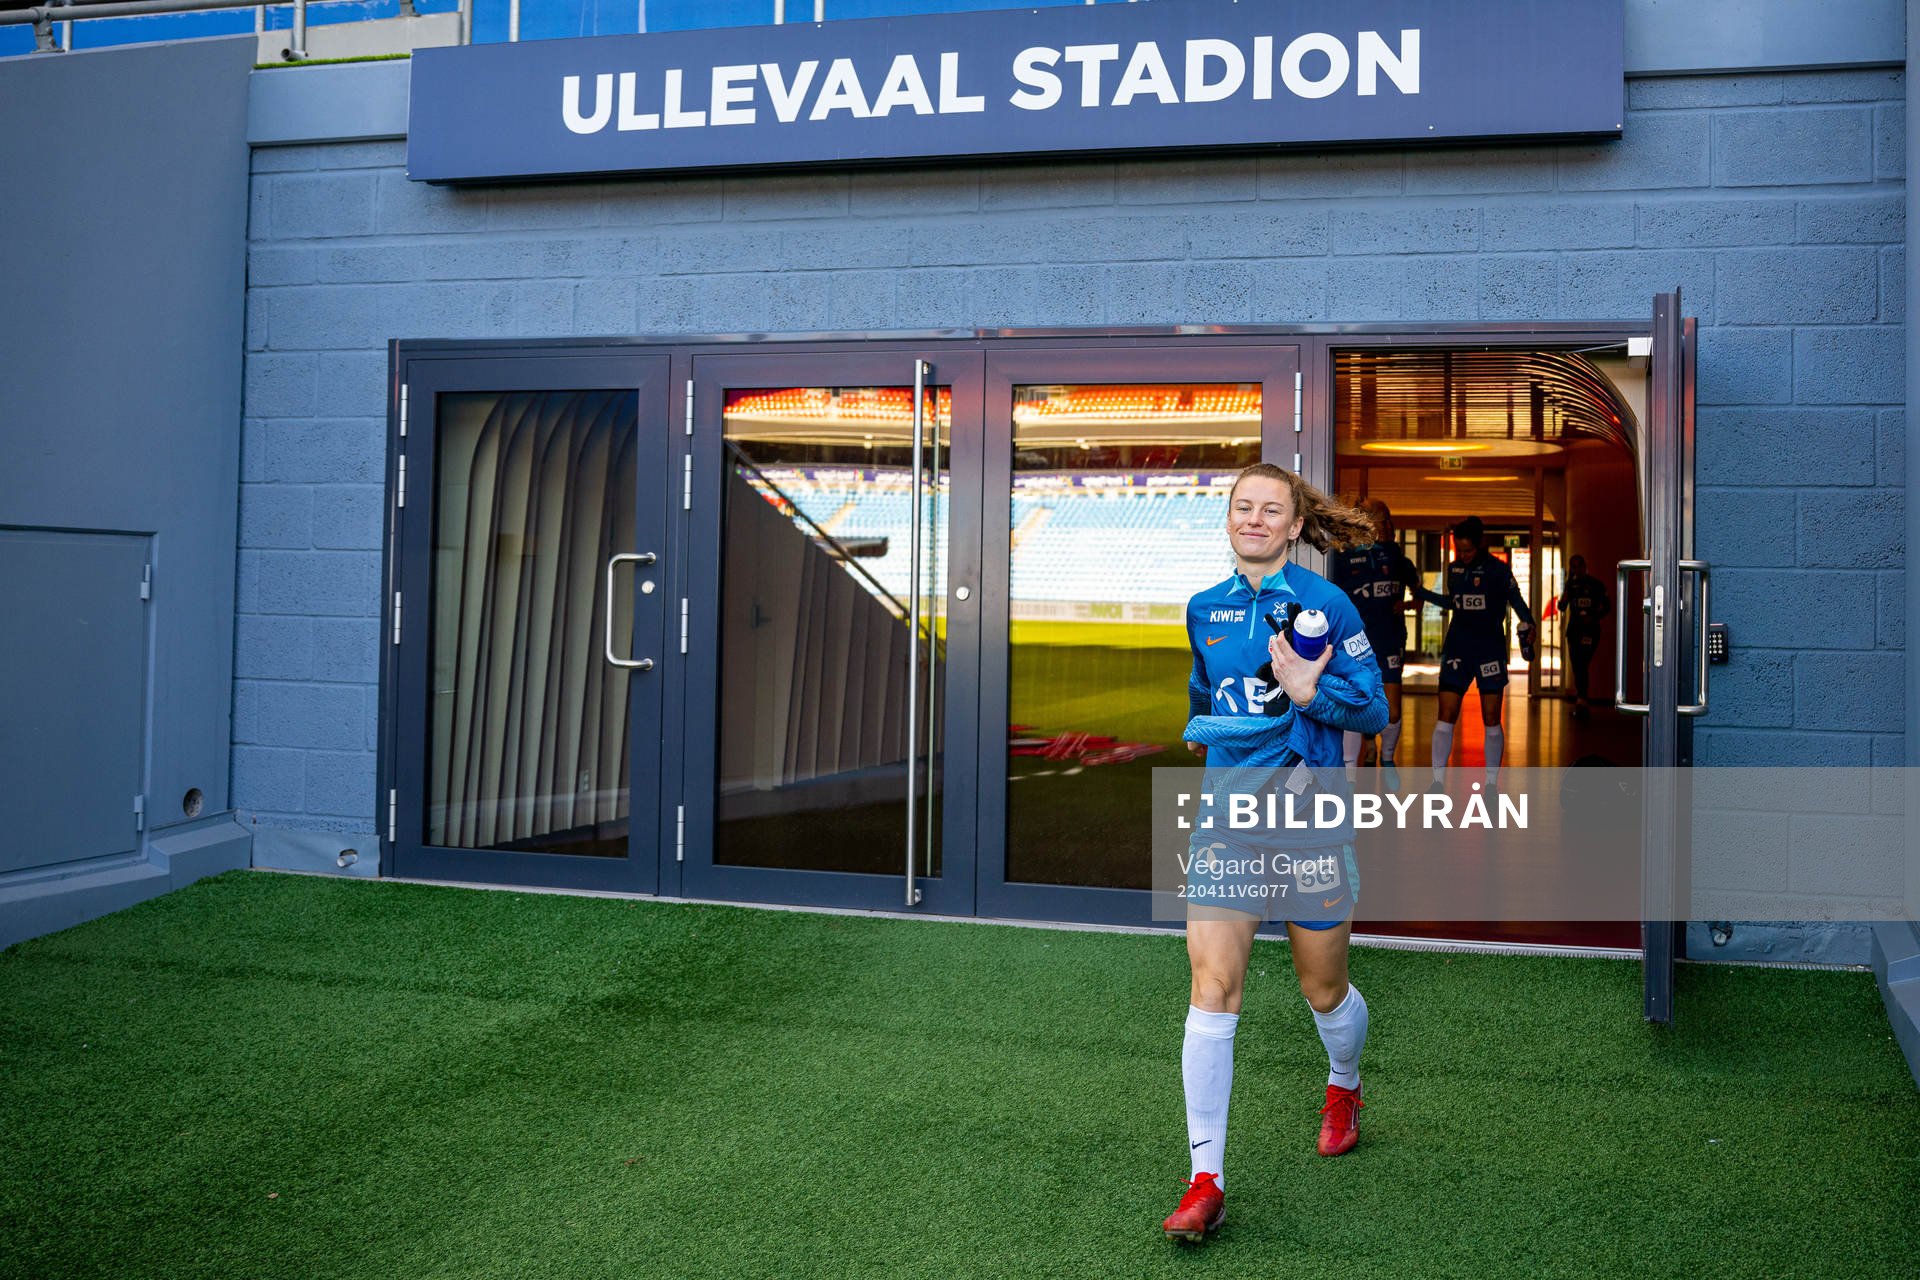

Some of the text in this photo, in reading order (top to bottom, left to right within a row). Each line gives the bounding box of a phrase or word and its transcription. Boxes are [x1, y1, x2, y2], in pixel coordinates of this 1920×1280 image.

[562, 29, 1420, 135] ULLEVAAL STADION
[1465, 597, 1483, 607] 5G
[1210, 610, 1234, 623] KIWI
[1483, 664, 1498, 674] 5G
